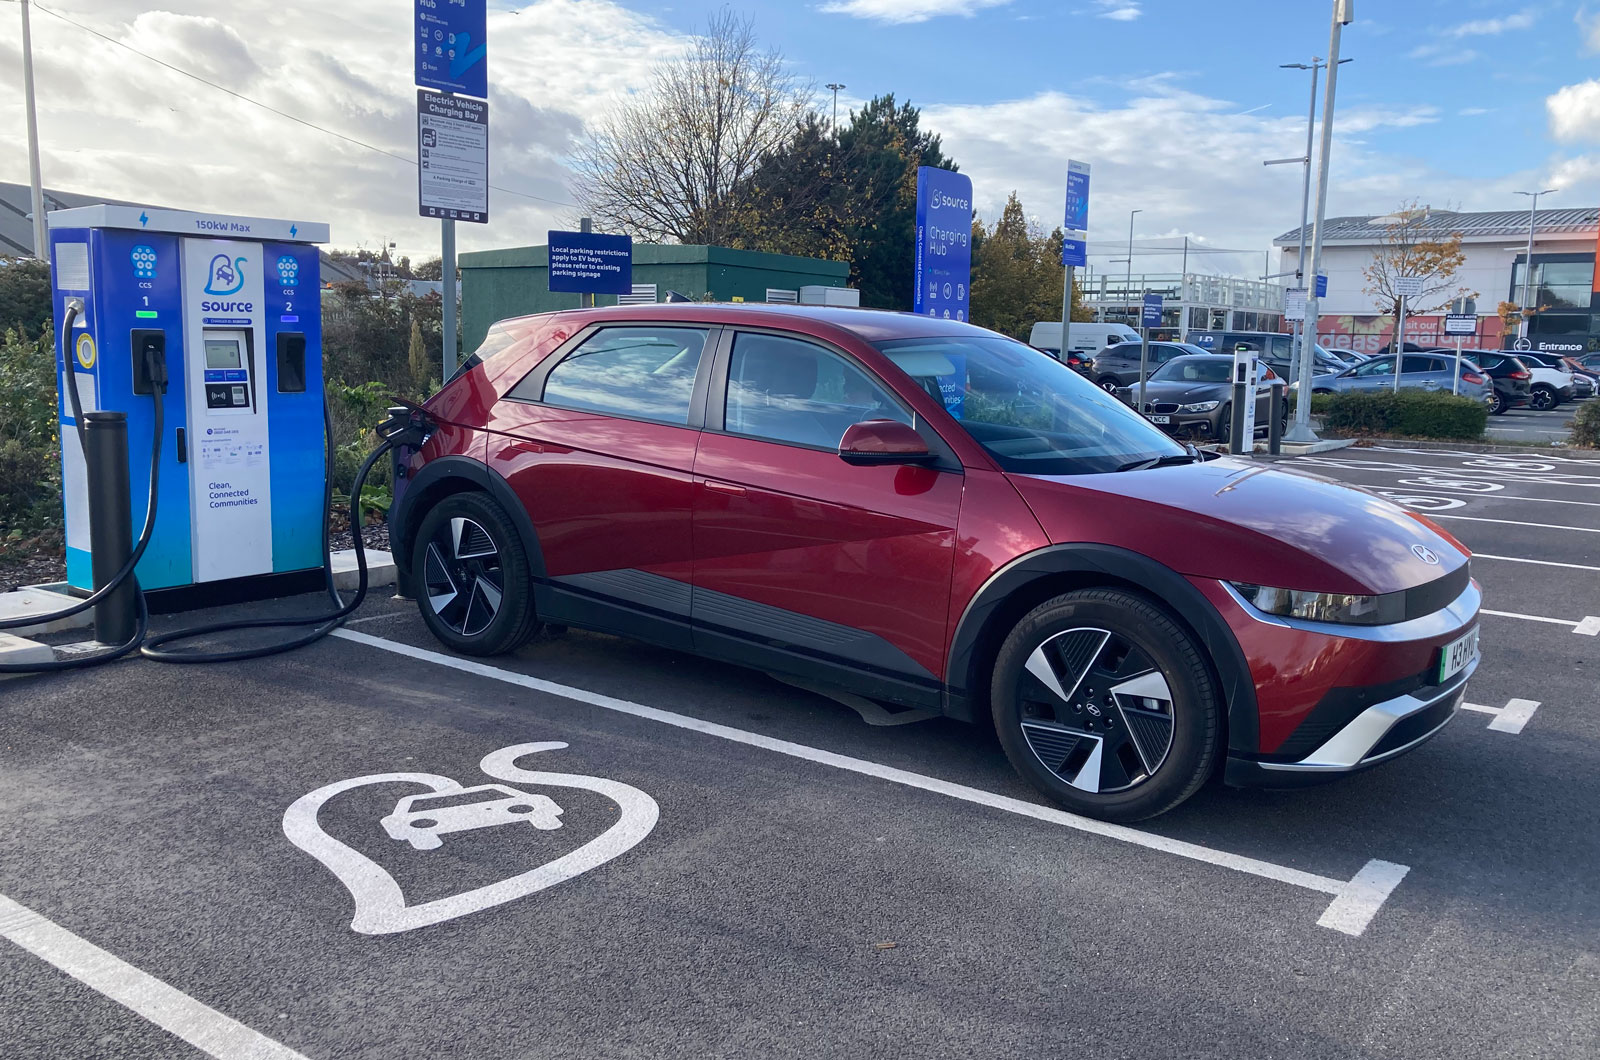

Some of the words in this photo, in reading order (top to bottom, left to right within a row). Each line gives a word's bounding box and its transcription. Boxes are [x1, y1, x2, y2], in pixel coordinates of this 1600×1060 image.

[424, 93, 454, 107] Electric
[456, 99, 483, 112] Vehicle
[429, 104, 463, 118] Charging
[464, 110, 479, 121] Bay
[942, 195, 968, 210] source
[196, 220, 228, 230] 150kW
[231, 223, 250, 232] Max
[930, 226, 967, 247] Charging
[595, 249, 628, 257] restrictions
[929, 242, 947, 256] Hub
[597, 264, 620, 272] existing
[142, 296, 149, 307] 1
[201, 301, 253, 313] source
[285, 302, 293, 312] 2
[1420, 322, 1437, 330] our
[1317, 329, 1380, 351] deas
[1538, 342, 1583, 351] Entrance
[208, 481, 232, 489] Clean,
[209, 489, 249, 499] Connected
[209, 497, 258, 509] Communities
